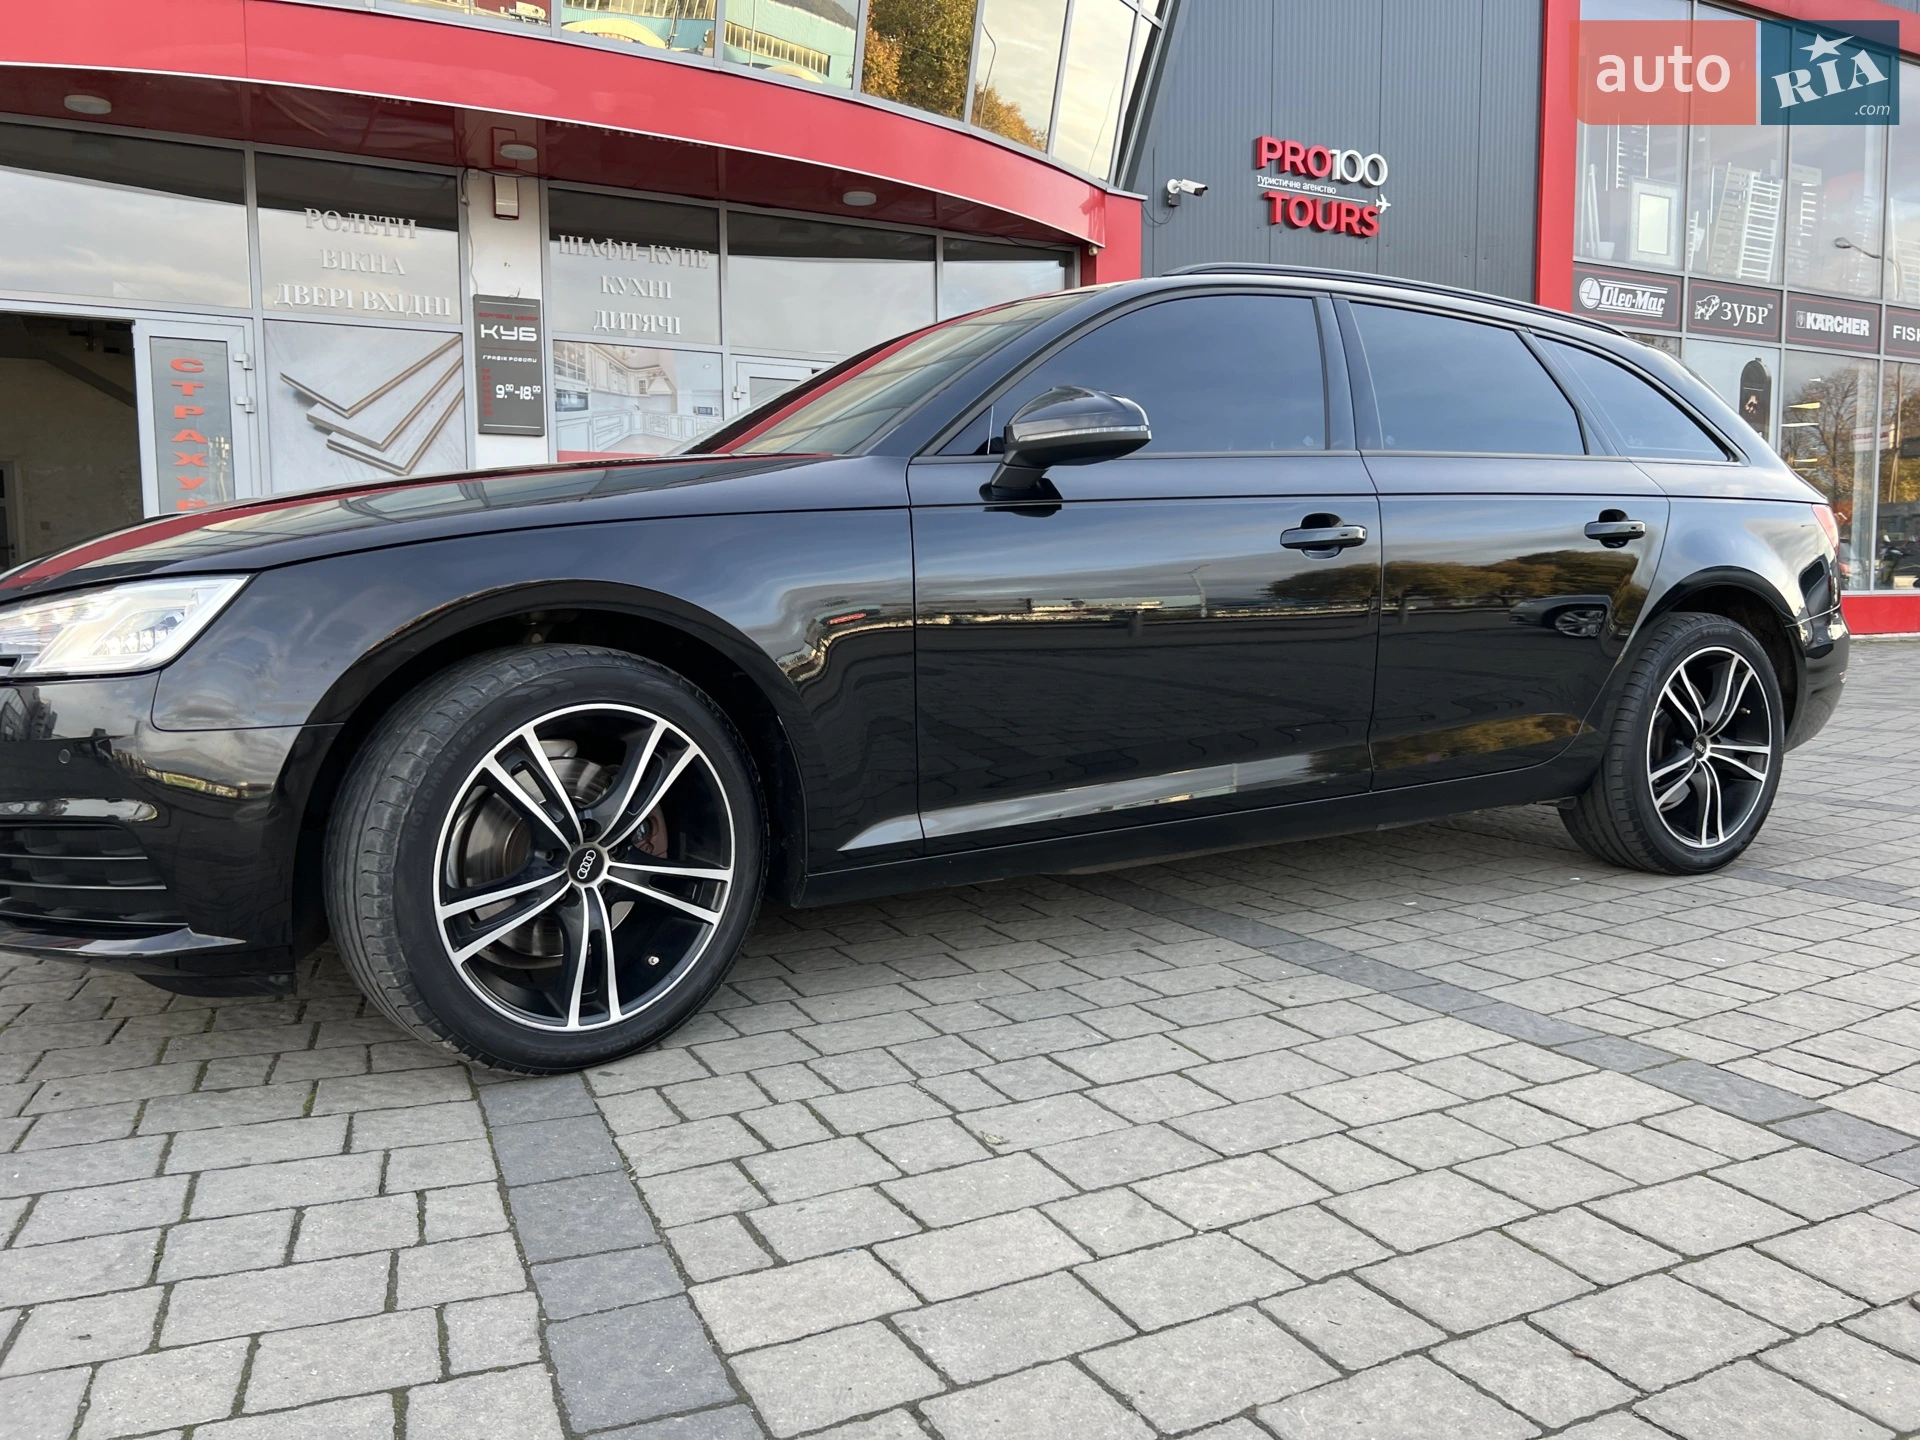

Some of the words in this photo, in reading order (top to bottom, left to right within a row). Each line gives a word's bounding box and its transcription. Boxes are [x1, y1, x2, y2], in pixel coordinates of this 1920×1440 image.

[1256, 135, 1389, 187] PRO100
[1256, 175, 1301, 189] туристичне
[1302, 182, 1337, 195] агенство
[304, 207, 417, 239] РОЛЕТИ
[1263, 190, 1381, 238] TOURS
[320, 248, 406, 276] ВІКНА
[559, 234, 710, 269] ШАФИ-КУПЕ
[274, 282, 355, 309] ДВЕРІ
[361, 290, 451, 318] ВХІДНІ
[600, 275, 672, 299] КУХНІ
[592, 309, 681, 335] ДИТЯЧІ
[1720, 301, 1769, 327] ЗУБР
[480, 323, 538, 342] КУБ
